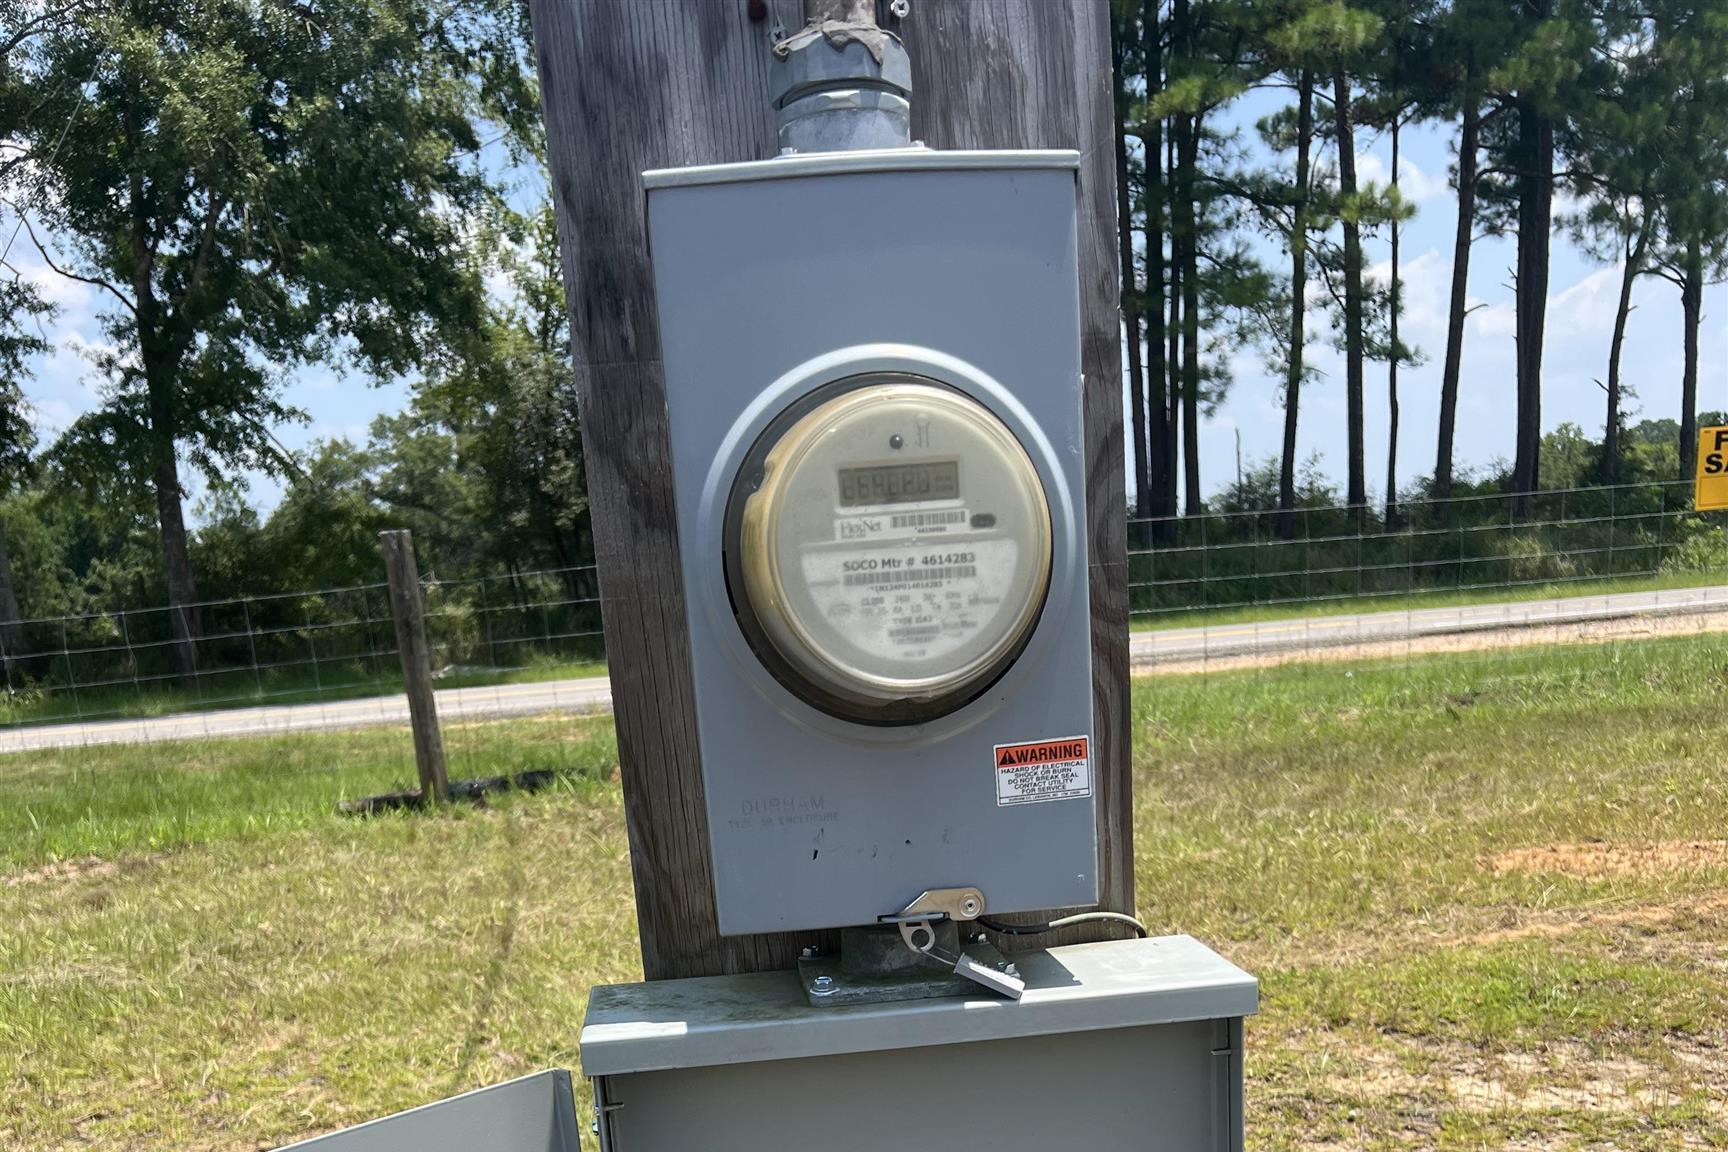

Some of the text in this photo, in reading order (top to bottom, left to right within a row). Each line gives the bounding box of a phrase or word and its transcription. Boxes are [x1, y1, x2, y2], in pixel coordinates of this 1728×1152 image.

[843, 552, 976, 572] SOCO Mtr # 4614283
[1015, 743, 1083, 763] WARNING
[1001, 765, 1030, 774] HAZARD
[1042, 760, 1085, 770] ELECTRICAL
[1014, 771, 1038, 779] SHOCK
[1052, 767, 1072, 775] BURN
[1036, 774, 1059, 783] BREAK
[1061, 772, 1079, 780] SEAL
[1014, 779, 1074, 790] CONTACT UTILITY
[1038, 785, 1067, 793] SERVICE
